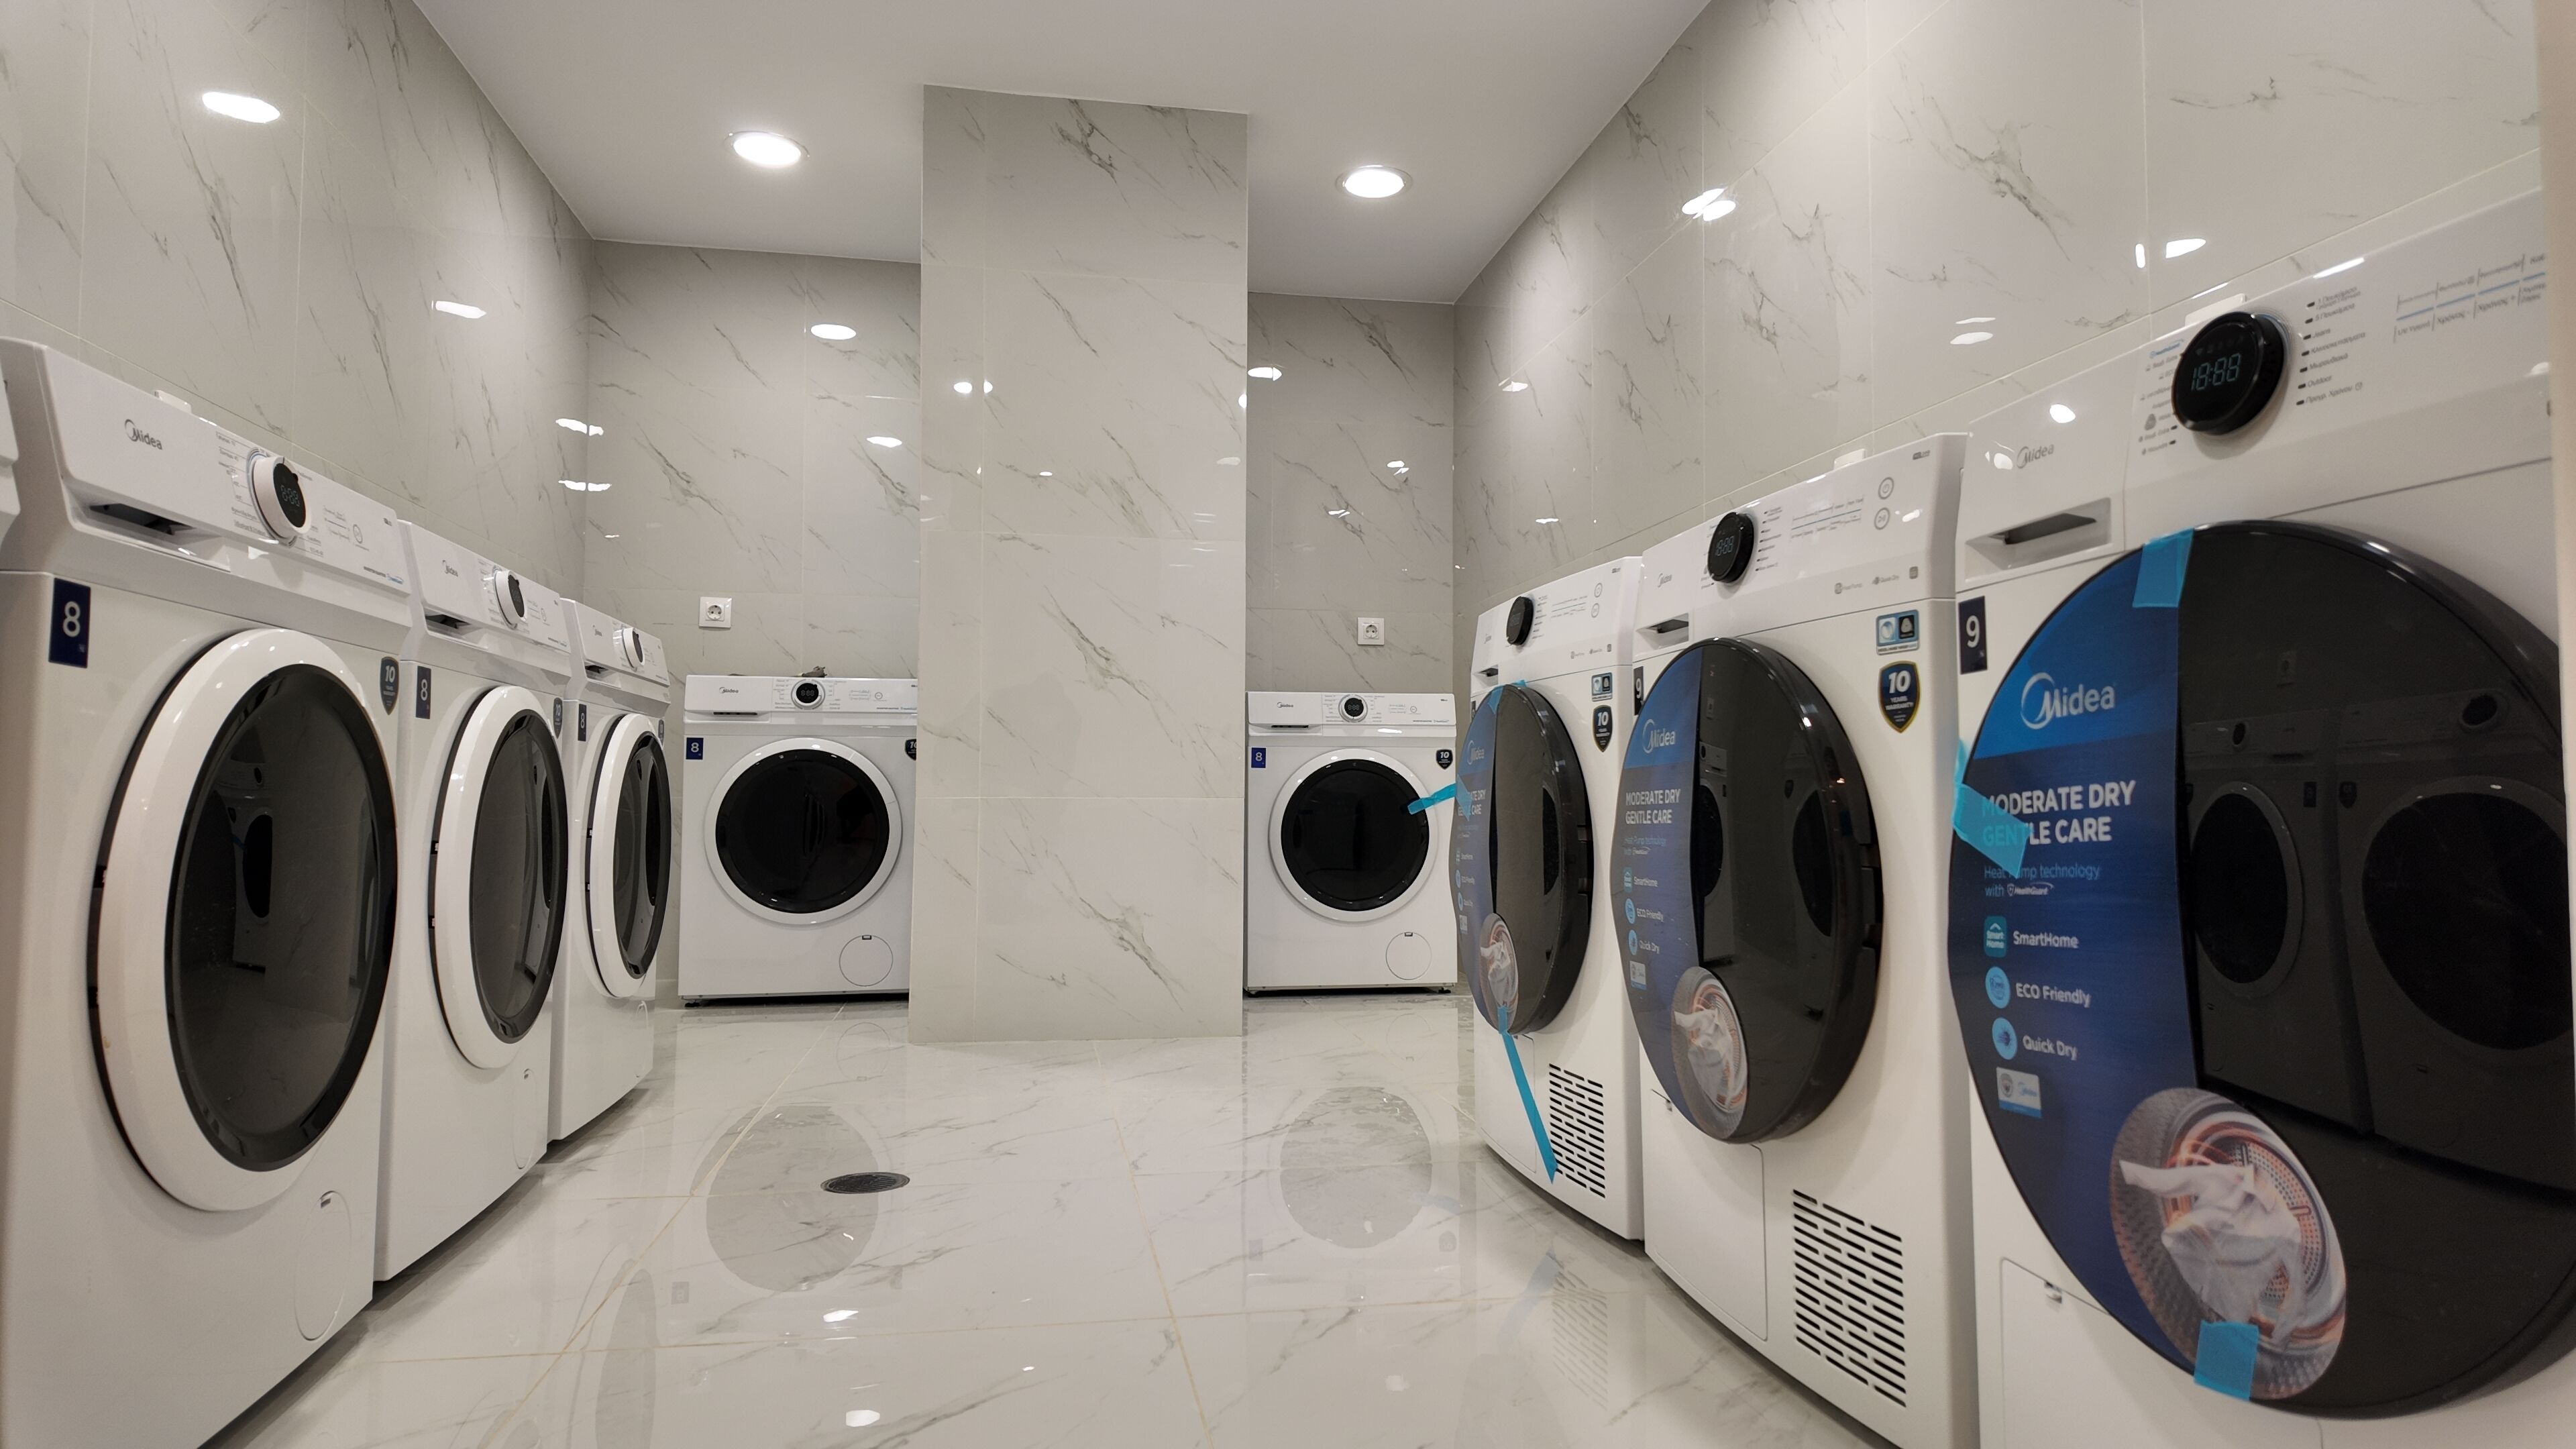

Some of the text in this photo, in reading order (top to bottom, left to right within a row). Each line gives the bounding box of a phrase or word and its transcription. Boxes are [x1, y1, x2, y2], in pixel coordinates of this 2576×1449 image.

[2313, 328, 2331, 338] Jeans
[2308, 375, 2332, 388] Outdoor
[125, 419, 162, 450] Midea
[2017, 444, 2054, 469] Midea
[1657, 573, 1672, 588] Midea
[63, 601, 80, 637] 8
[1966, 615, 1980, 648] 9
[385, 665, 395, 683] 10
[1888, 670, 1911, 694] 10
[421, 679, 428, 701] 8
[1636, 678, 1642, 699] 9
[1890, 696, 1909, 704] YEARS
[2021, 673, 2115, 729] Midea
[580, 712, 585, 729] 8
[1597, 711, 1609, 727] 10
[1643, 719, 1676, 754] Midea
[690, 742, 700, 753] 8
[1255, 752, 1263, 761] 8
[1626, 788, 1681, 806] MODERATE DRY
[1982, 780, 2137, 818] MODERATE DRY
[1625, 809, 1672, 824] GENTLE CARE
[1982, 816, 2112, 848] GENTLE CARE
[2040, 861, 2100, 880] technology
[1633, 875, 1658, 888] SmartHome
[1985, 883, 2004, 897] with
[1646, 909, 1664, 923] Friendly
[2012, 930, 2079, 949] SmartHome
[2016, 982, 2091, 1008] ECO Friendly
[2023, 1034, 2078, 1061] Quick Dry
